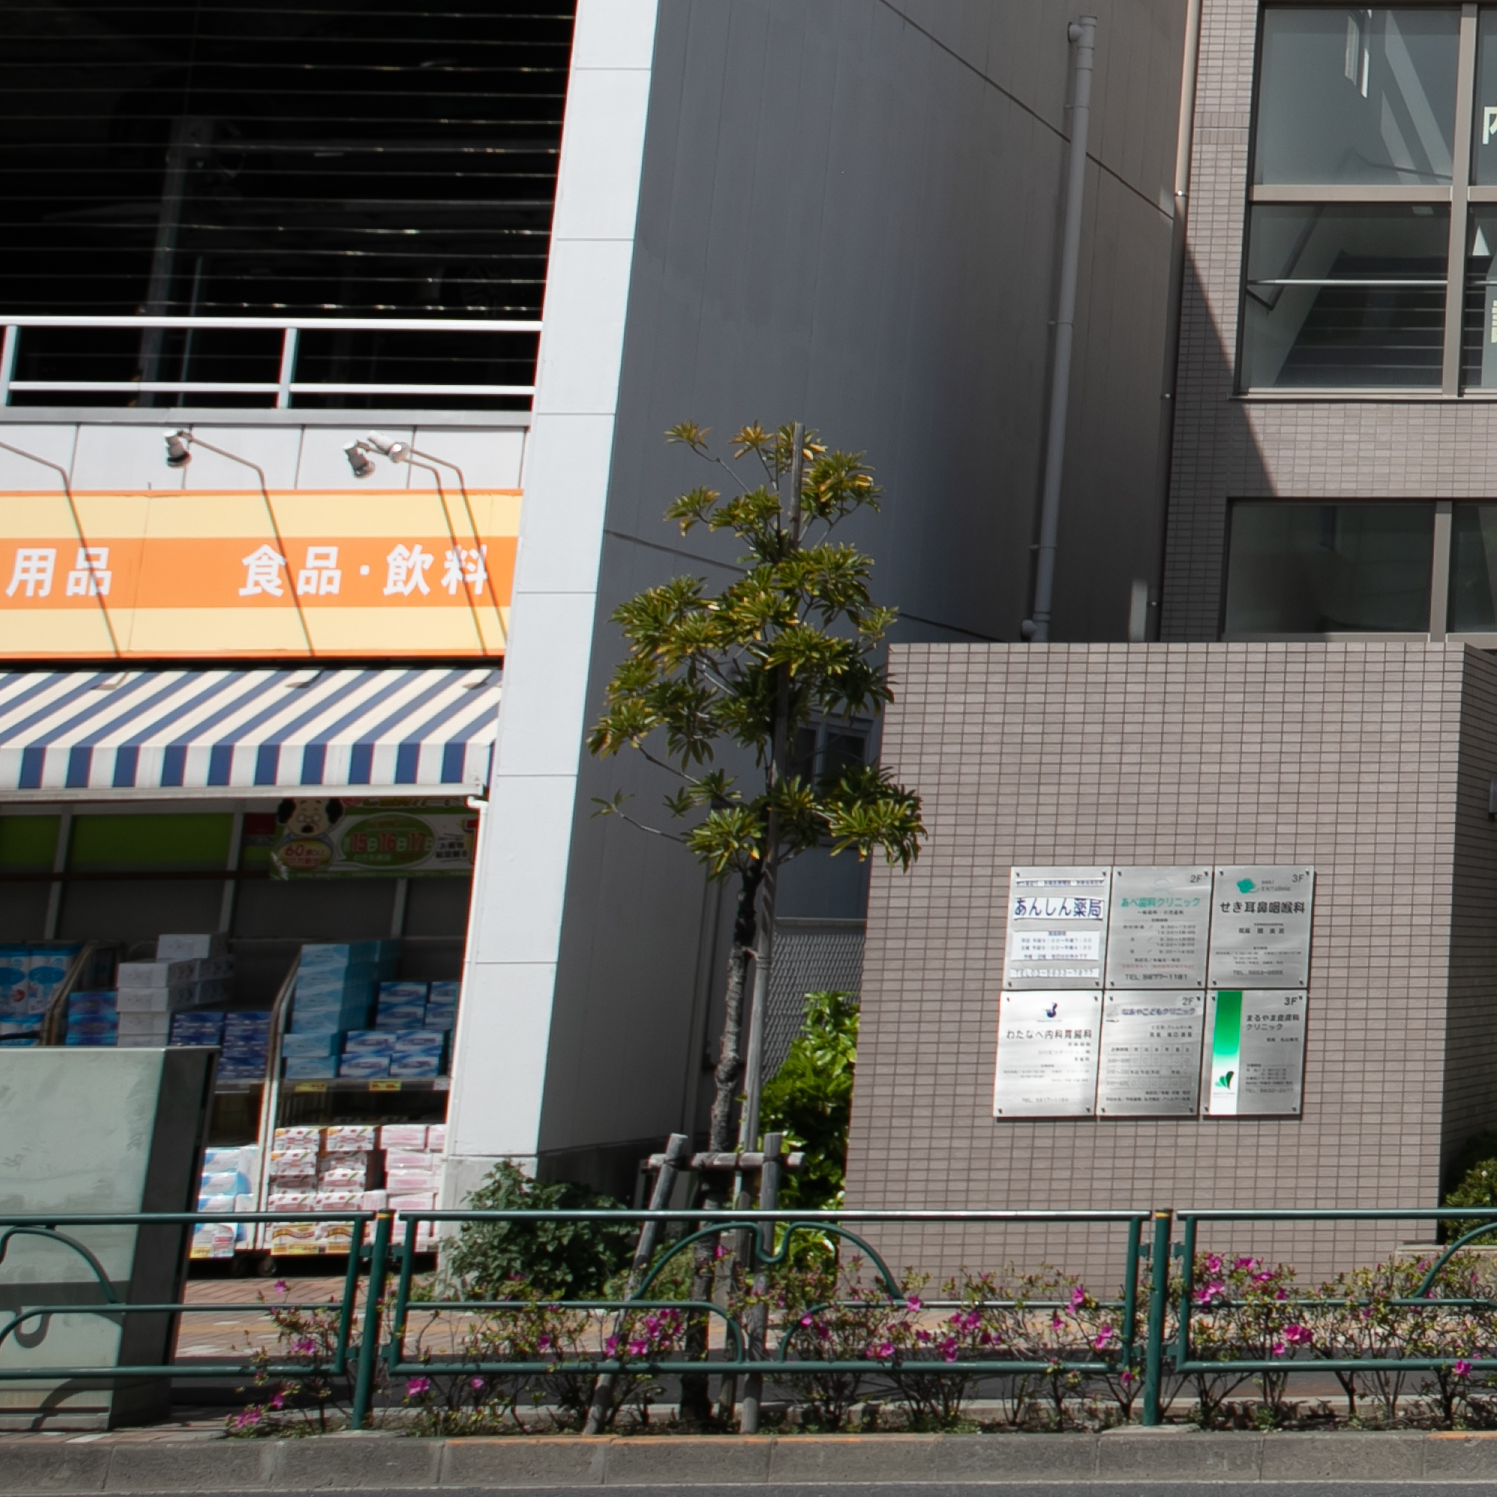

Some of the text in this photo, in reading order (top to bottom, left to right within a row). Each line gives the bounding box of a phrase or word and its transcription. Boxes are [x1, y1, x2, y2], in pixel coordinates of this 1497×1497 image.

[1292, 874, 1304, 883] 3F
[1014, 897, 1102, 917] あんしん薬局
[1284, 997, 1297, 1006] 3F
